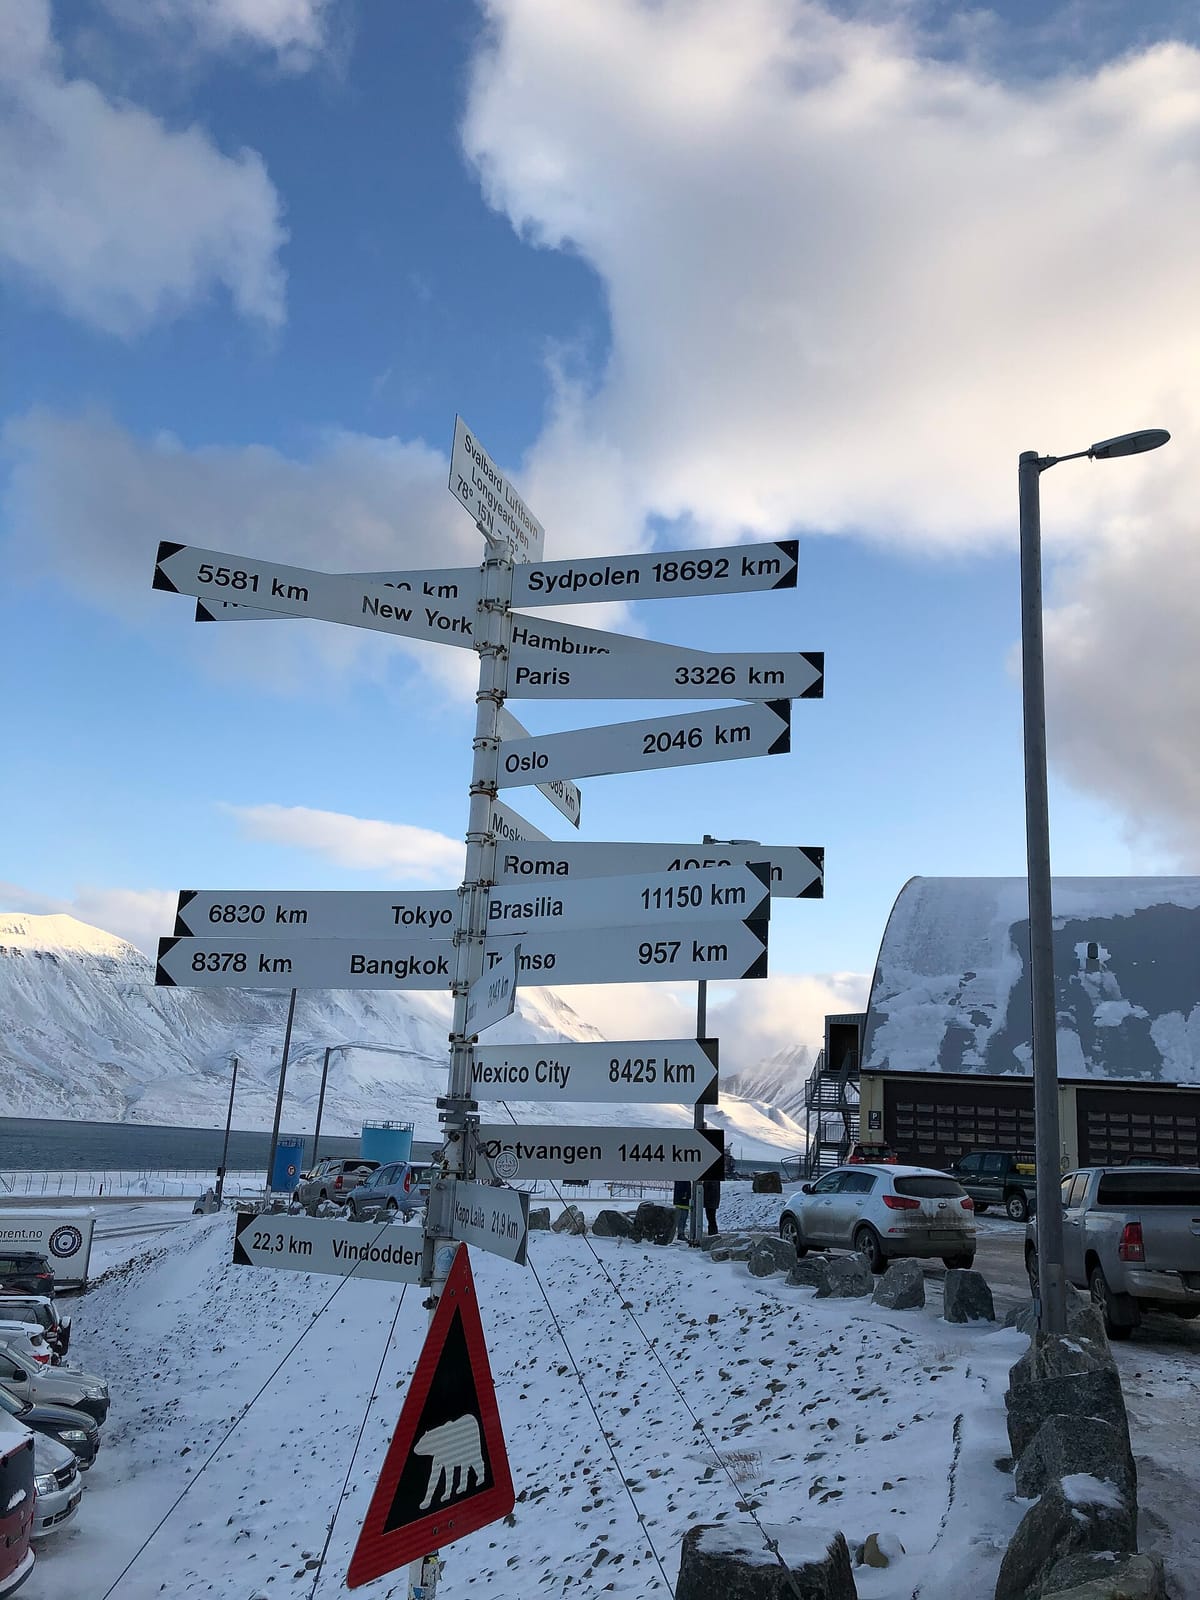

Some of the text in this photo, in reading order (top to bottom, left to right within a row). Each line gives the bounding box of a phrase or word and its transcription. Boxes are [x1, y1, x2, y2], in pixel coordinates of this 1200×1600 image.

[457, 474, 474, 500] 78°
[464, 434, 539, 539] Svalbard Lufthavn
[471, 466, 530, 550] Longyearbyen
[197, 563, 309, 602] 5581 km
[423, 581, 458, 599] km
[528, 556, 781, 594] Sydpolen 18692 km
[362, 595, 473, 635] New York
[515, 666, 785, 685] Paris 3326 km
[505, 724, 751, 773] Oslo 2046 km
[565, 787, 575, 811] km
[503, 855, 570, 876] Roma
[208, 904, 453, 928] 6830 km Tokyo
[488, 882, 746, 921] Brasilia 11150 km
[191, 952, 449, 979] 8378 km Bangkok
[486, 940, 728, 970] Trmsø 957 km
[471, 1058, 695, 1089] Mexico City 8425 km
[617, 1143, 665, 1163] 1444
[672, 1143, 701, 1163] km
[454, 1200, 519, 1241] Kapp Laila 21,9 km
[252, 1231, 285, 1255] 22,3
[288, 1234, 313, 1256] km
[332, 1239, 423, 1266] Vindodden
